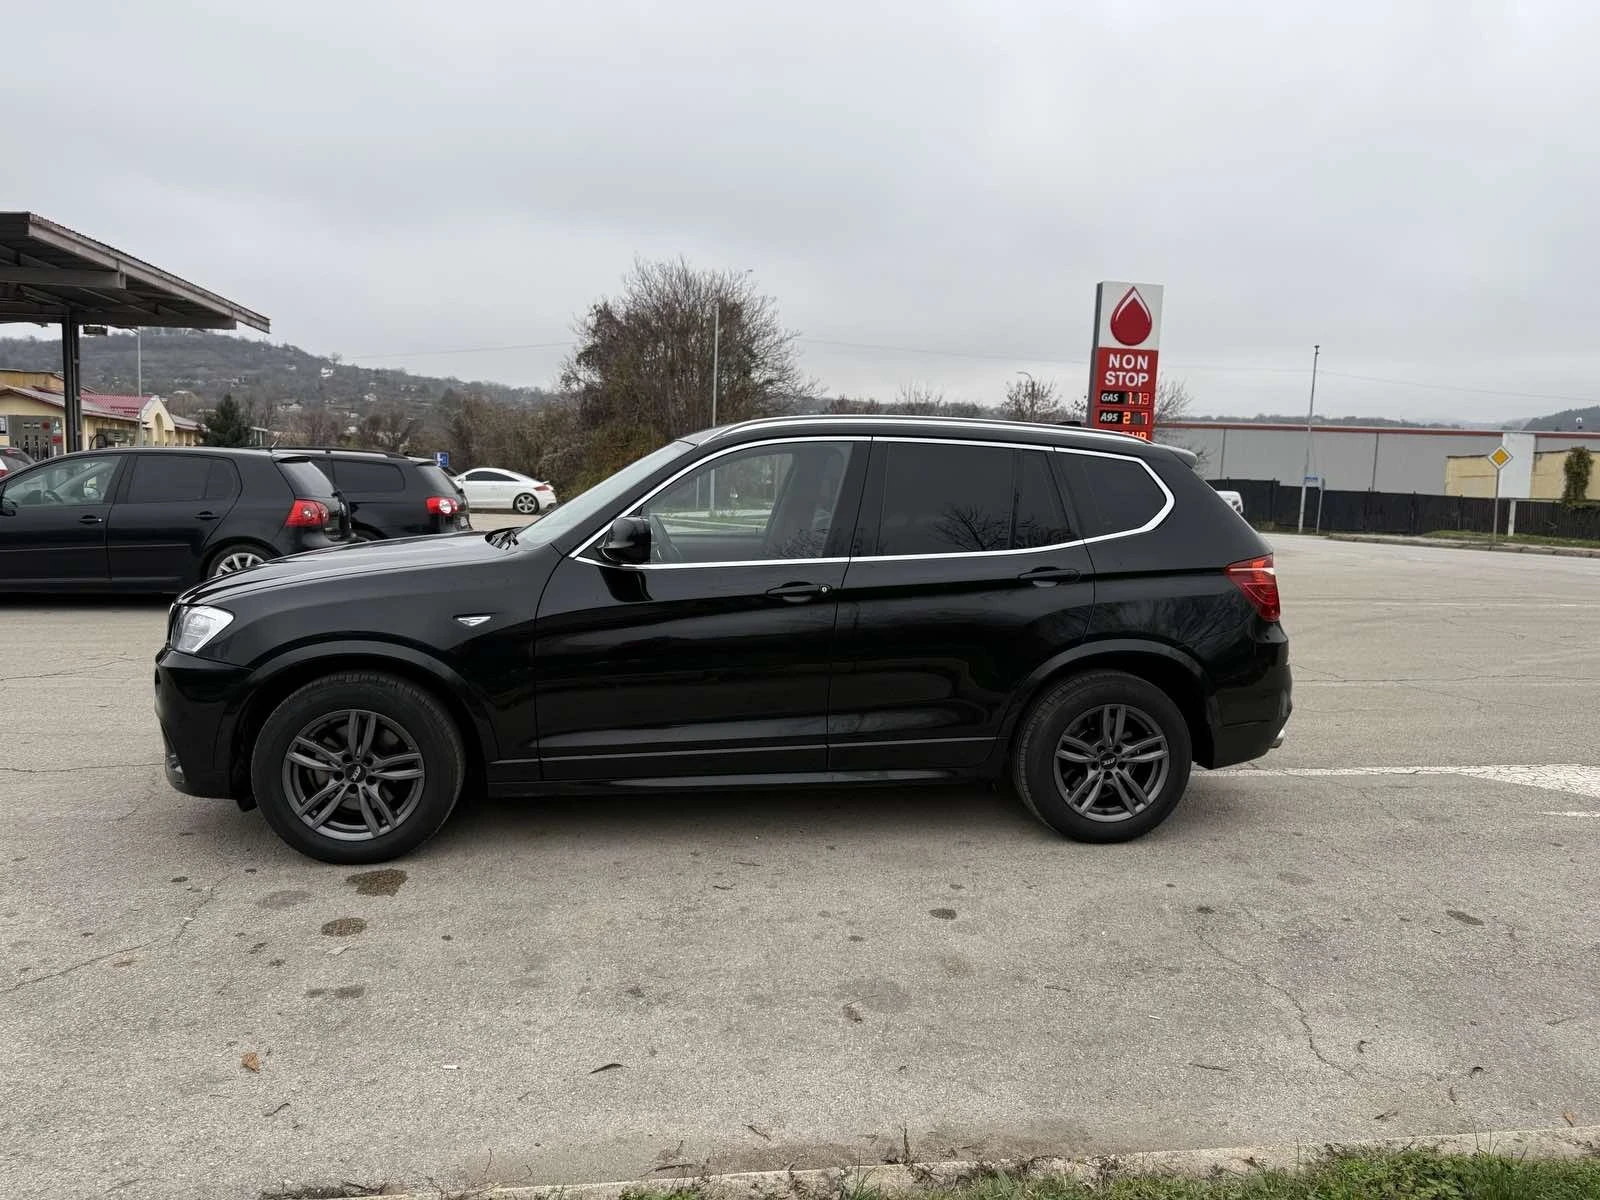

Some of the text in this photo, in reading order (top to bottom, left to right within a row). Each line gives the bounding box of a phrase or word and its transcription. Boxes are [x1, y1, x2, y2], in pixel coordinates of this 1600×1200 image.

[1108, 354, 1149, 370] NON
[1105, 371, 1149, 387] STOP
[1101, 393, 1119, 402] GAS
[1100, 412, 1118, 422] A95
